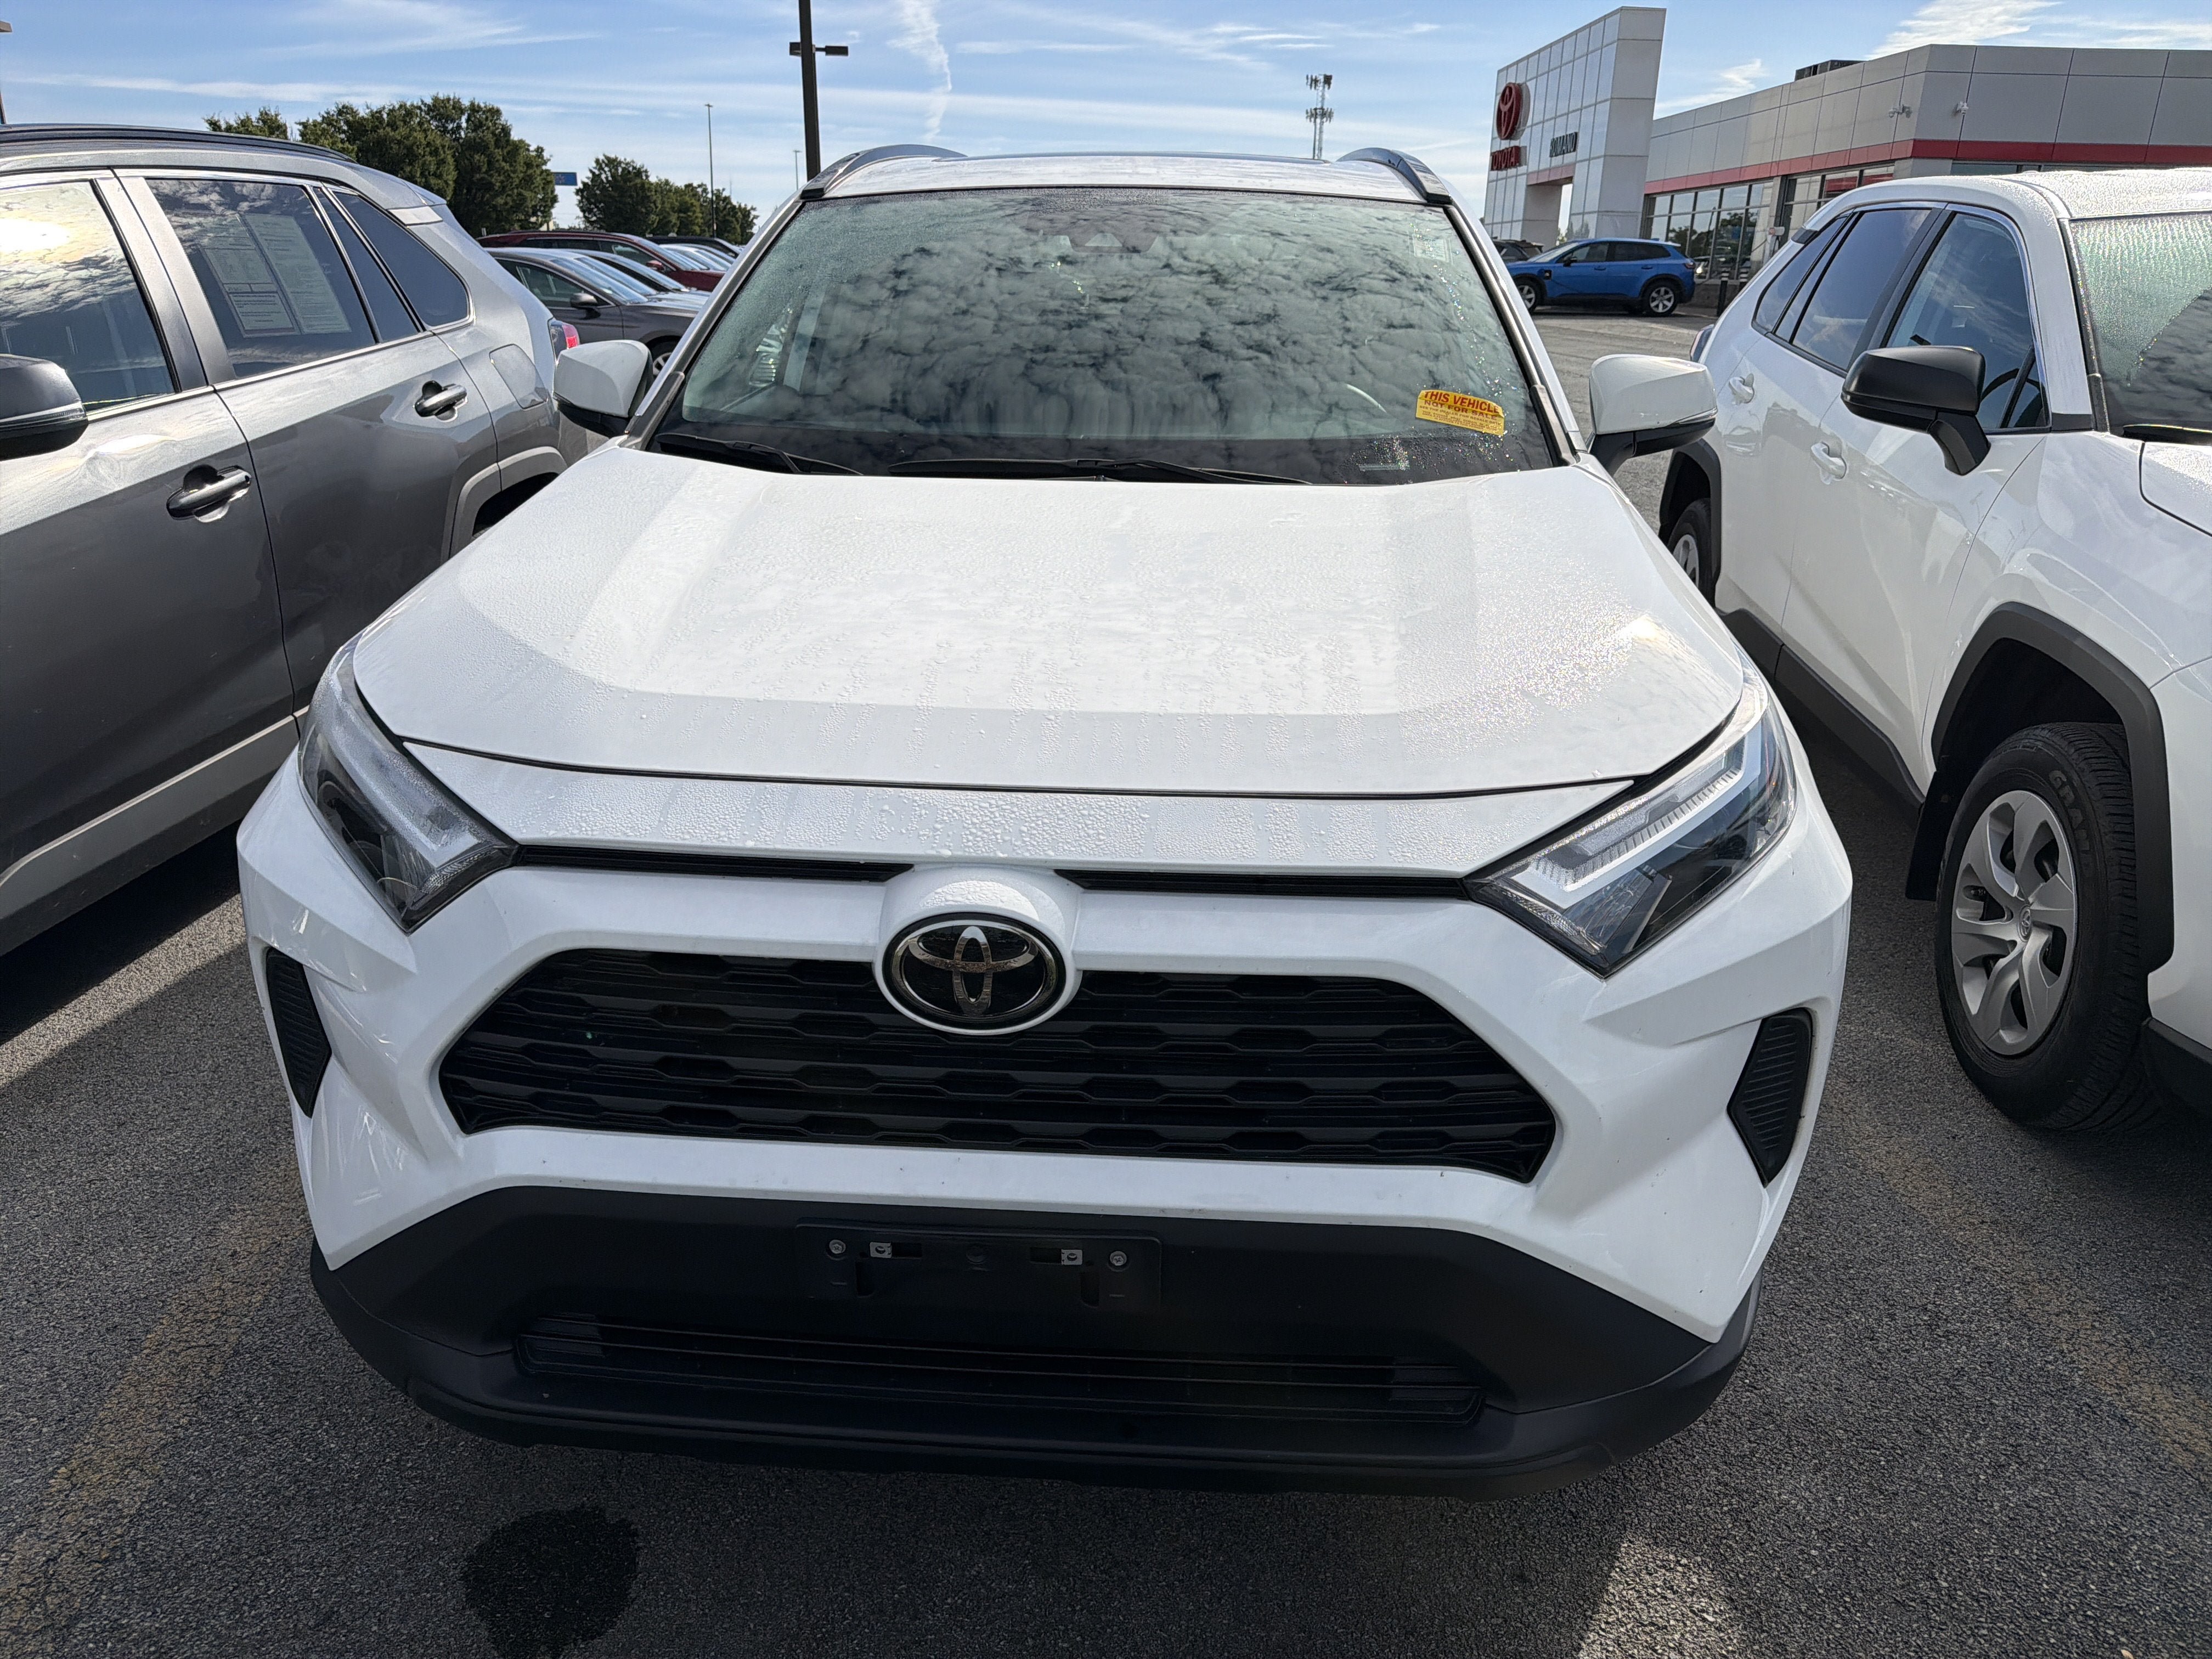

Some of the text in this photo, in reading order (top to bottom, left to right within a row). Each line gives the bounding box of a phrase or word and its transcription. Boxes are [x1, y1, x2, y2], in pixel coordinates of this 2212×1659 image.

[1491, 146, 1519, 171] TOYOTA
[1425, 391, 1498, 413] THIS VEHICLE
[1448, 405, 1468, 413] FOR
[1472, 411, 1497, 420] SALE
